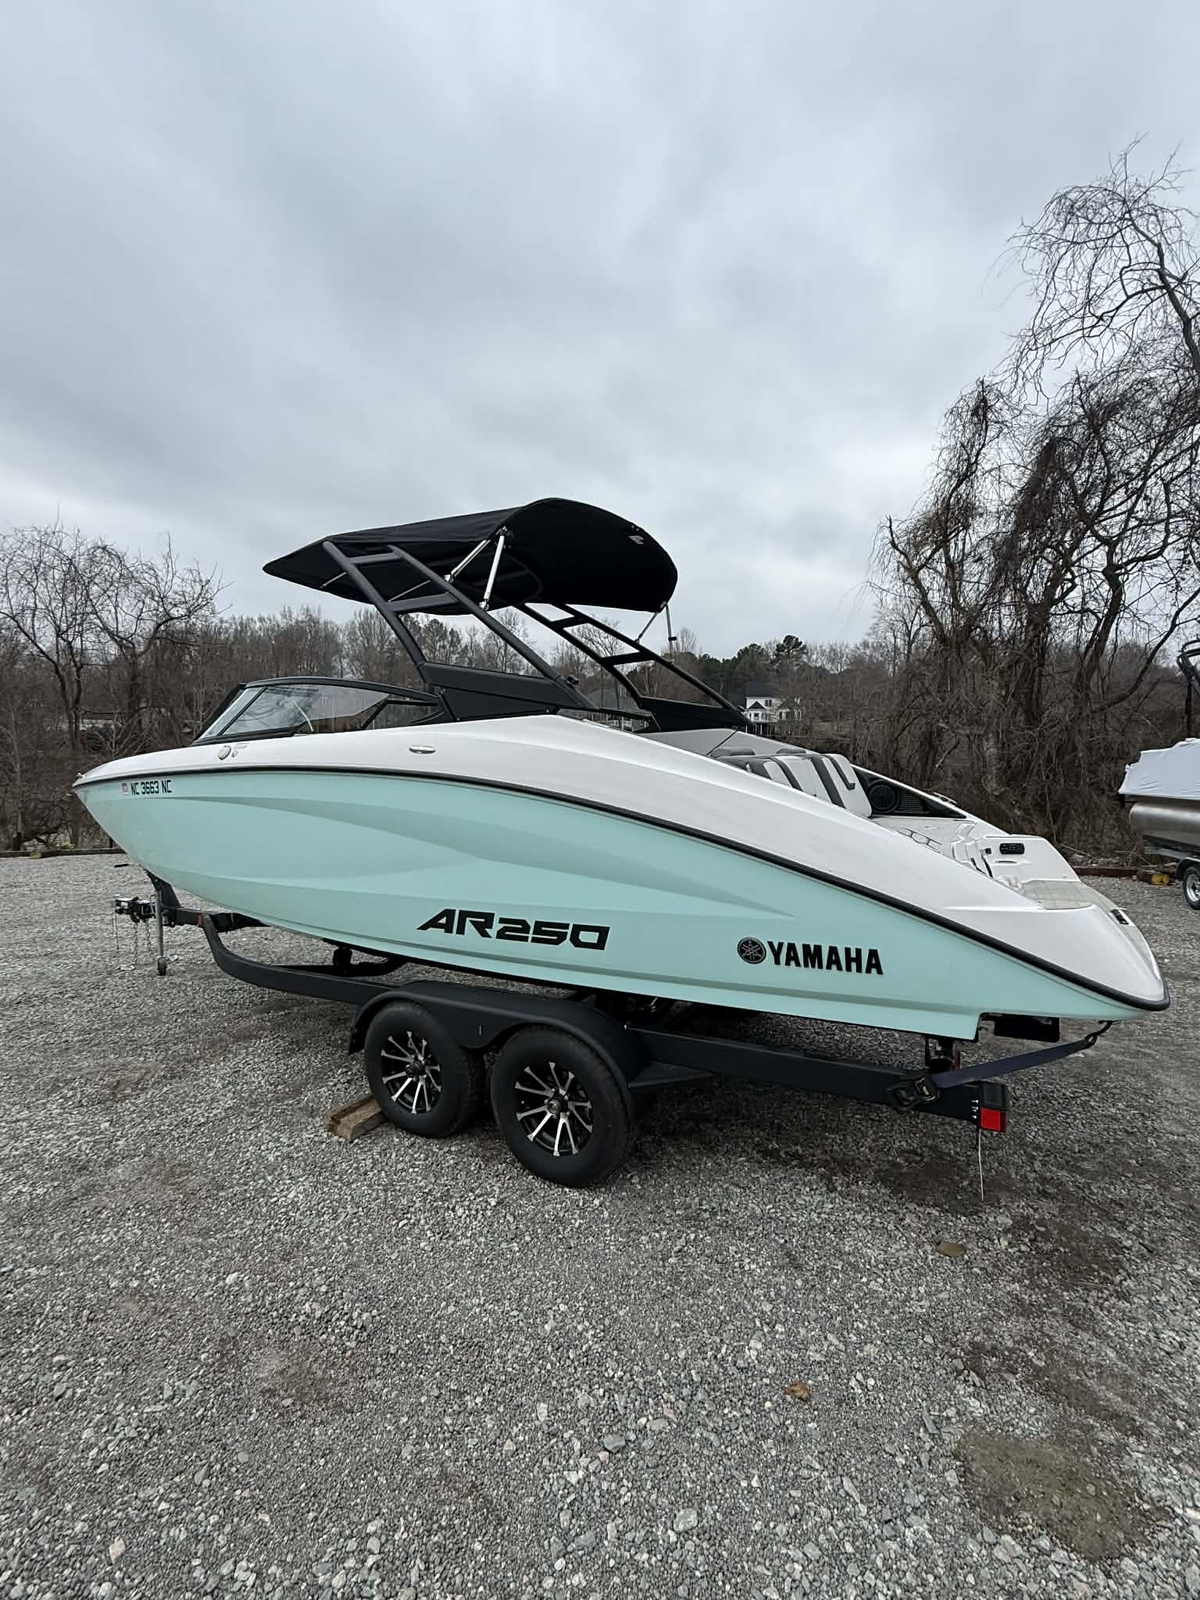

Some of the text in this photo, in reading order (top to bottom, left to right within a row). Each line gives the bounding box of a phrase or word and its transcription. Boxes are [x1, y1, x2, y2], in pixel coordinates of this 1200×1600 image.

[130, 782, 140, 795] NC
[140, 780, 160, 794] 3663
[161, 779, 173, 793] NC
[416, 908, 610, 951] AR250
[767, 940, 884, 975] YAMAHA
